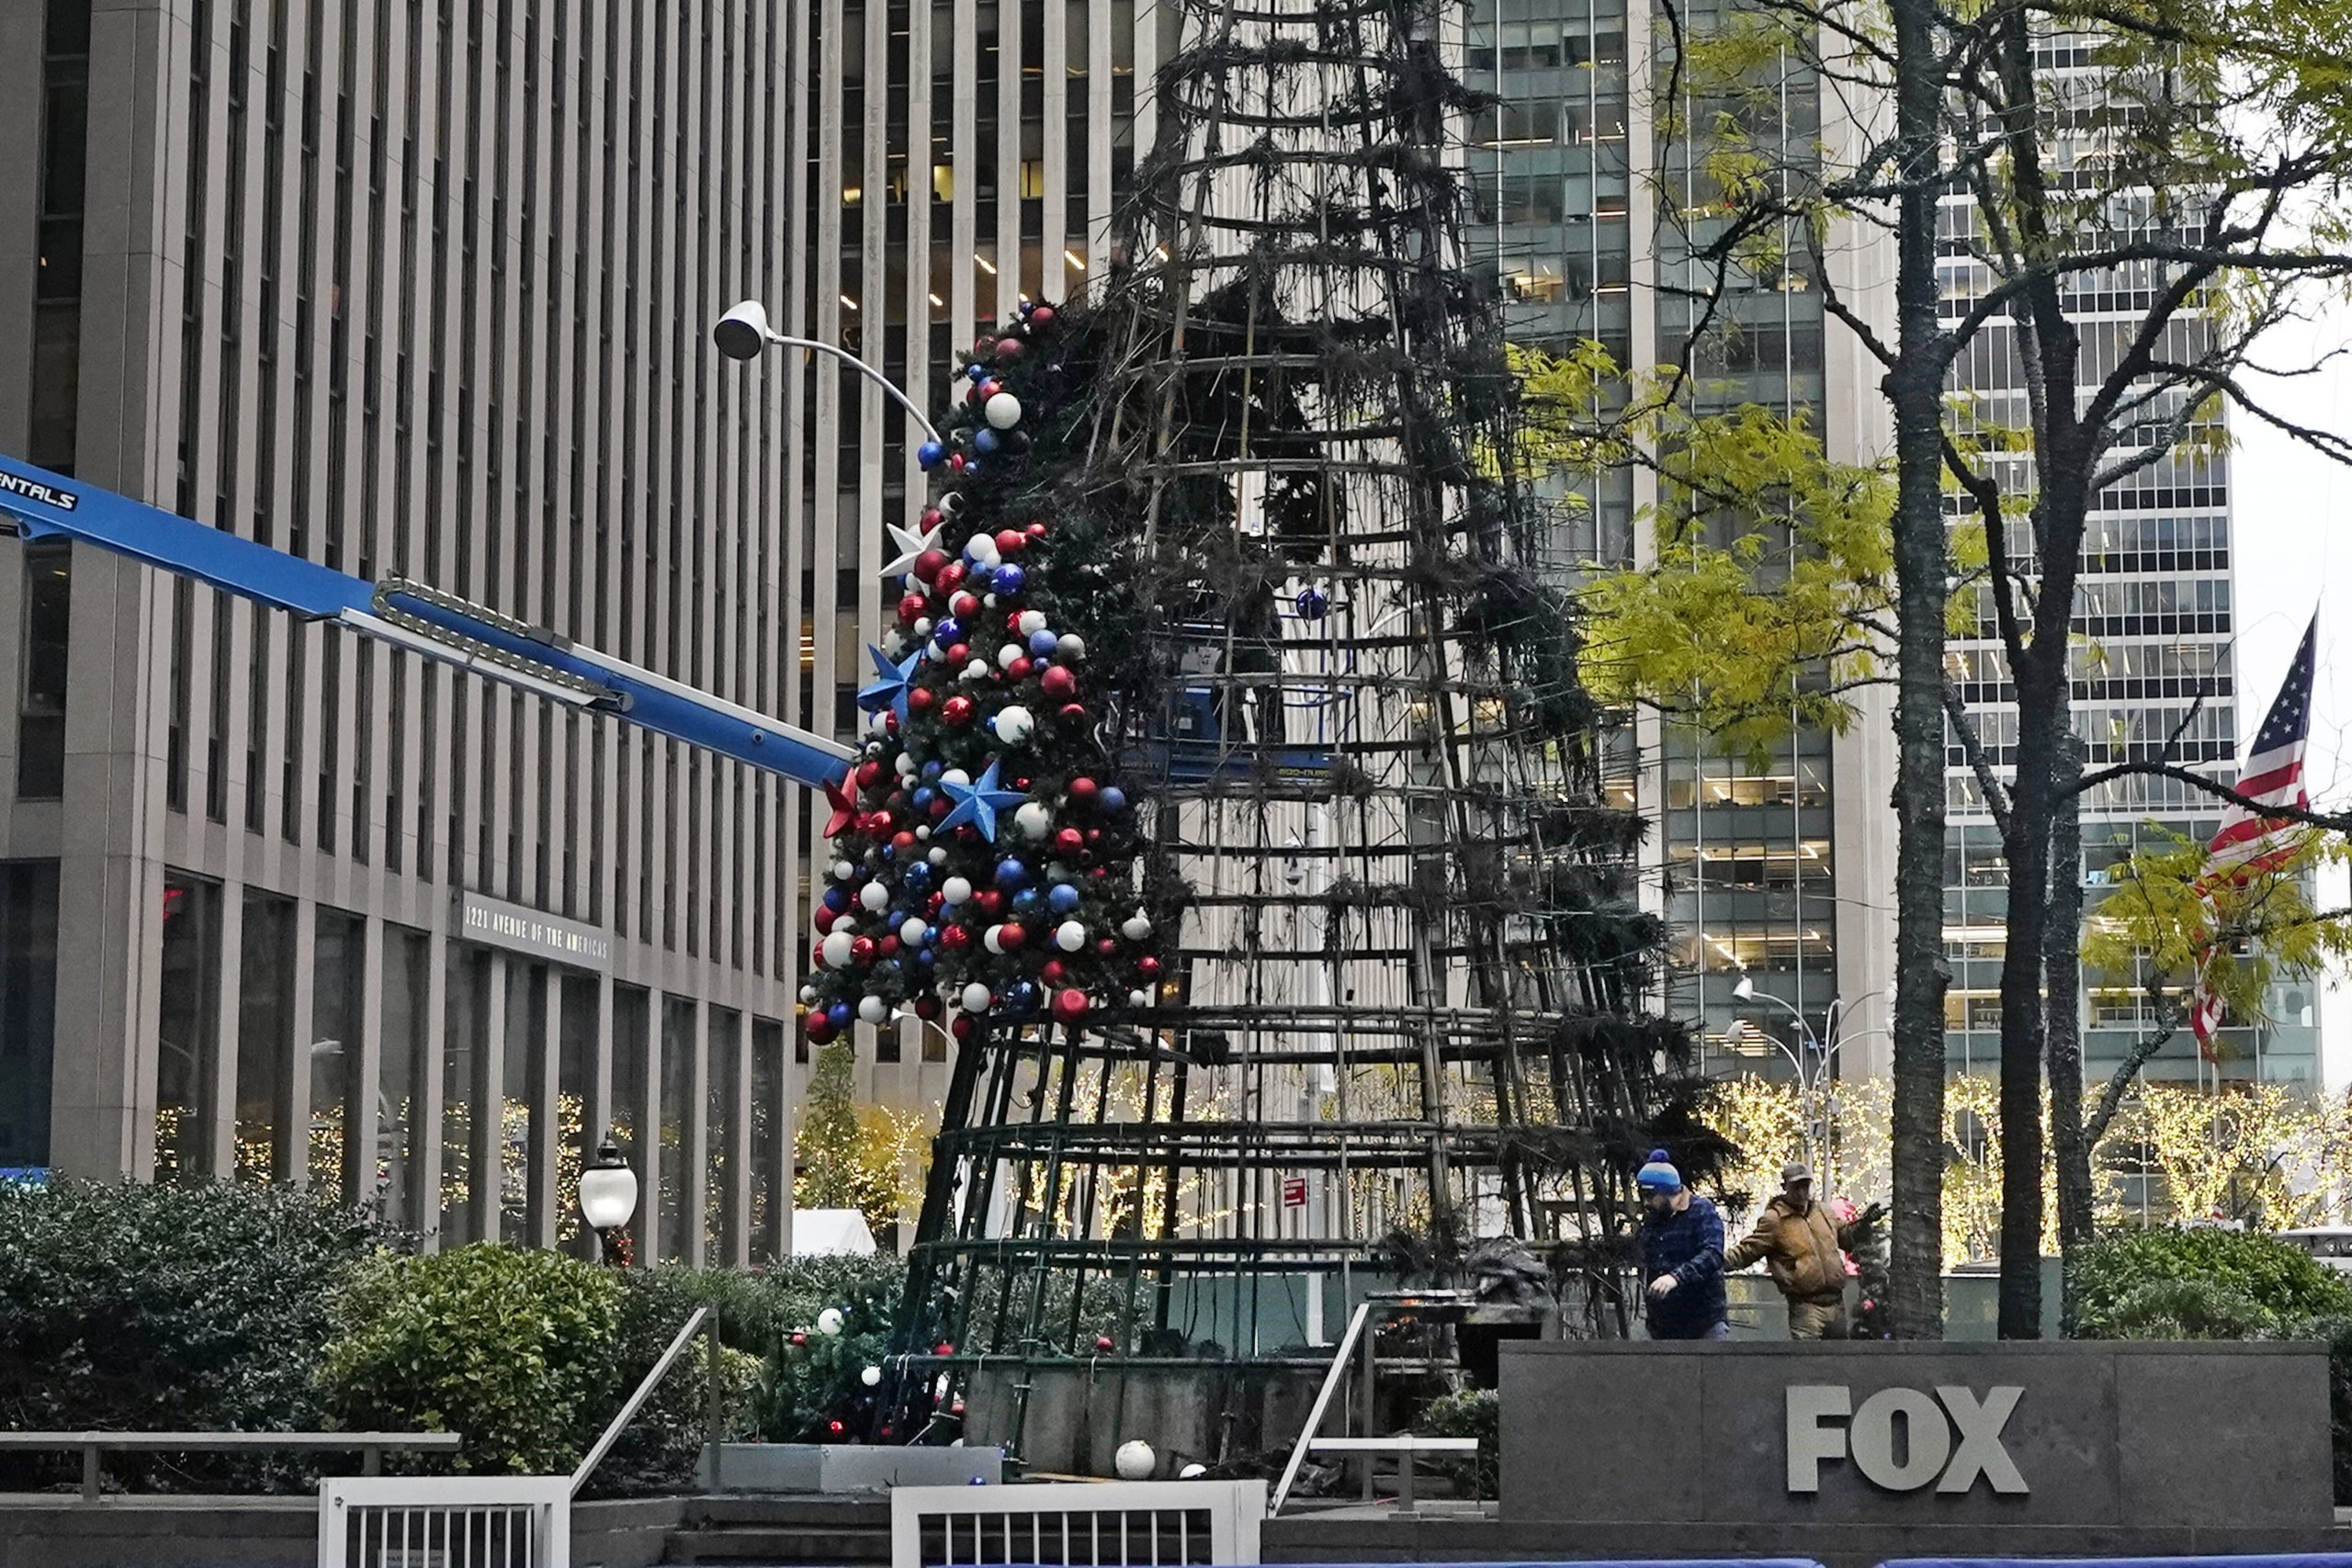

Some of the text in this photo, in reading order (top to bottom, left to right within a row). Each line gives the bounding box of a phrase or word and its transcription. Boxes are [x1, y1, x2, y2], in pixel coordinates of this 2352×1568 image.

[466, 906, 607, 959] 1221 AVENUE OF THE AMERICAS
[1786, 1385, 2030, 1493] FOX
